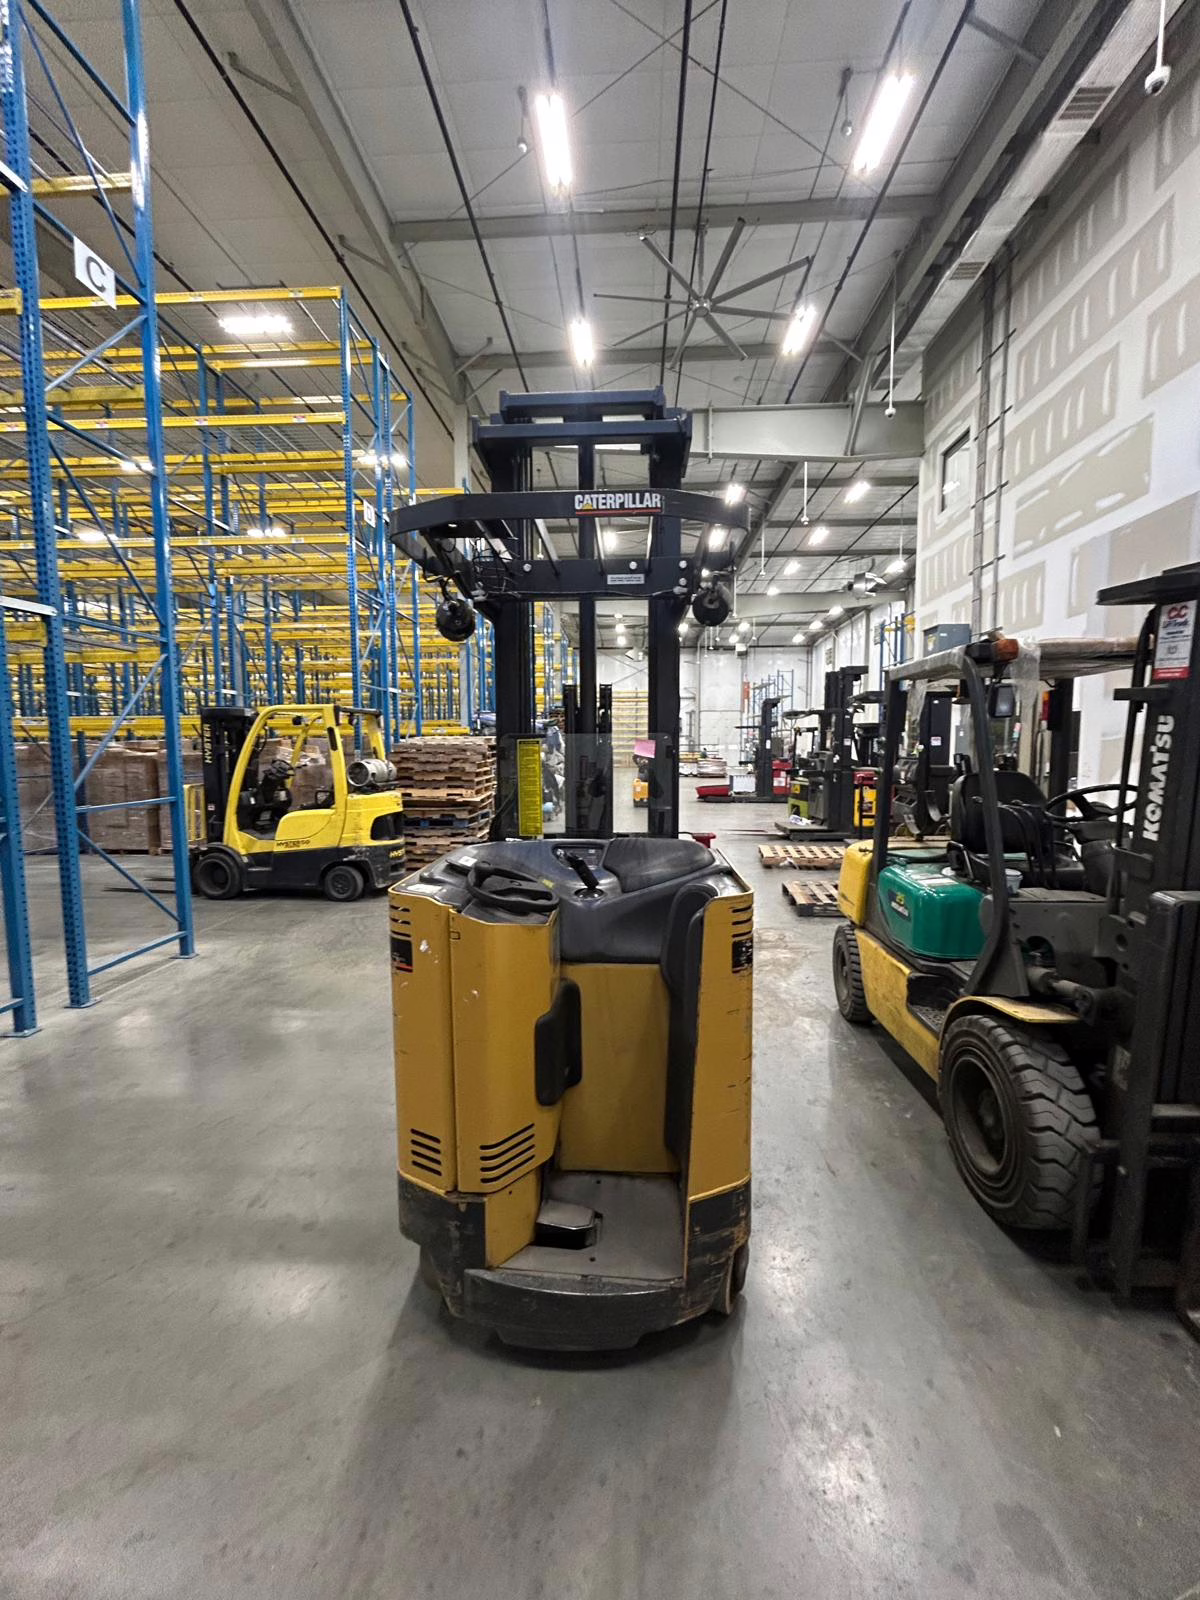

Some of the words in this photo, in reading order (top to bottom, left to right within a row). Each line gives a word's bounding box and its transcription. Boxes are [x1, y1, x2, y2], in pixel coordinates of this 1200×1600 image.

[86, 256, 106, 293] C
[574, 492, 661, 510] CATERPILLAR
[203, 724, 213, 764] HYSTER
[1142, 715, 1175, 842] KOMATSU
